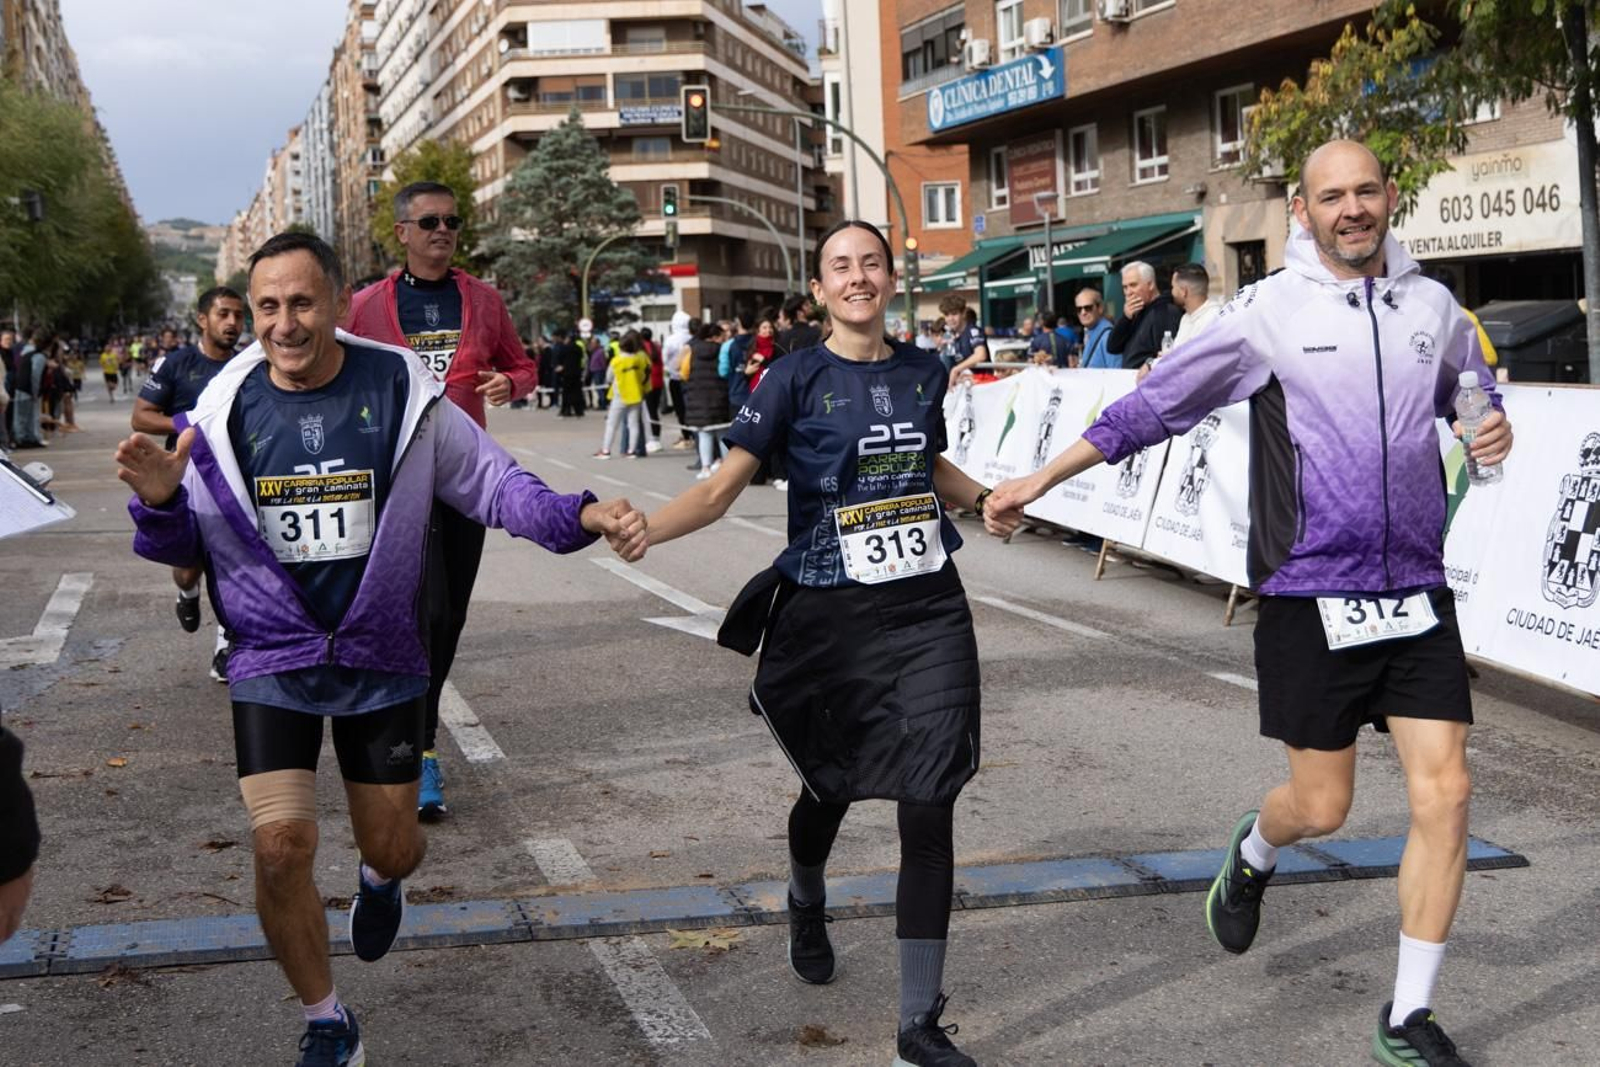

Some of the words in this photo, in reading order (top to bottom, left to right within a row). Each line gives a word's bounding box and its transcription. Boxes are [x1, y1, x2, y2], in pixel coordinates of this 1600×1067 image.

[944, 77, 989, 110] CLÍNICA
[989, 61, 1037, 97] DENTAL
[1440, 194, 1473, 223] 603
[1480, 189, 1516, 219] 045
[1523, 183, 1560, 215] 046
[420, 352, 455, 373] 25
[858, 422, 927, 456] 25
[858, 452, 925, 466] CARRERA
[858, 462, 926, 475] POPULAR
[260, 481, 282, 496] XXV
[284, 478, 325, 488] CARRERA
[326, 475, 367, 485] POPULAR
[284, 488, 289, 496] y
[295, 484, 319, 495] gran
[325, 482, 368, 492] caminata
[821, 476, 838, 492] IES
[867, 474, 889, 483] gran
[841, 509, 864, 526] XXV
[864, 502, 900, 514] CARRERA
[900, 497, 933, 508] POPULAR
[876, 510, 896, 520] gran
[900, 503, 935, 514] caminata
[280, 507, 345, 542] 311
[1179, 523, 1191, 536] DE
[865, 527, 927, 564] 313
[803, 554, 818, 586] ANTA
[1445, 564, 1472, 585] nicipal
[1344, 599, 1409, 625] 312
[1506, 607, 1556, 636] CIUDAD
[1556, 621, 1575, 642] DE
